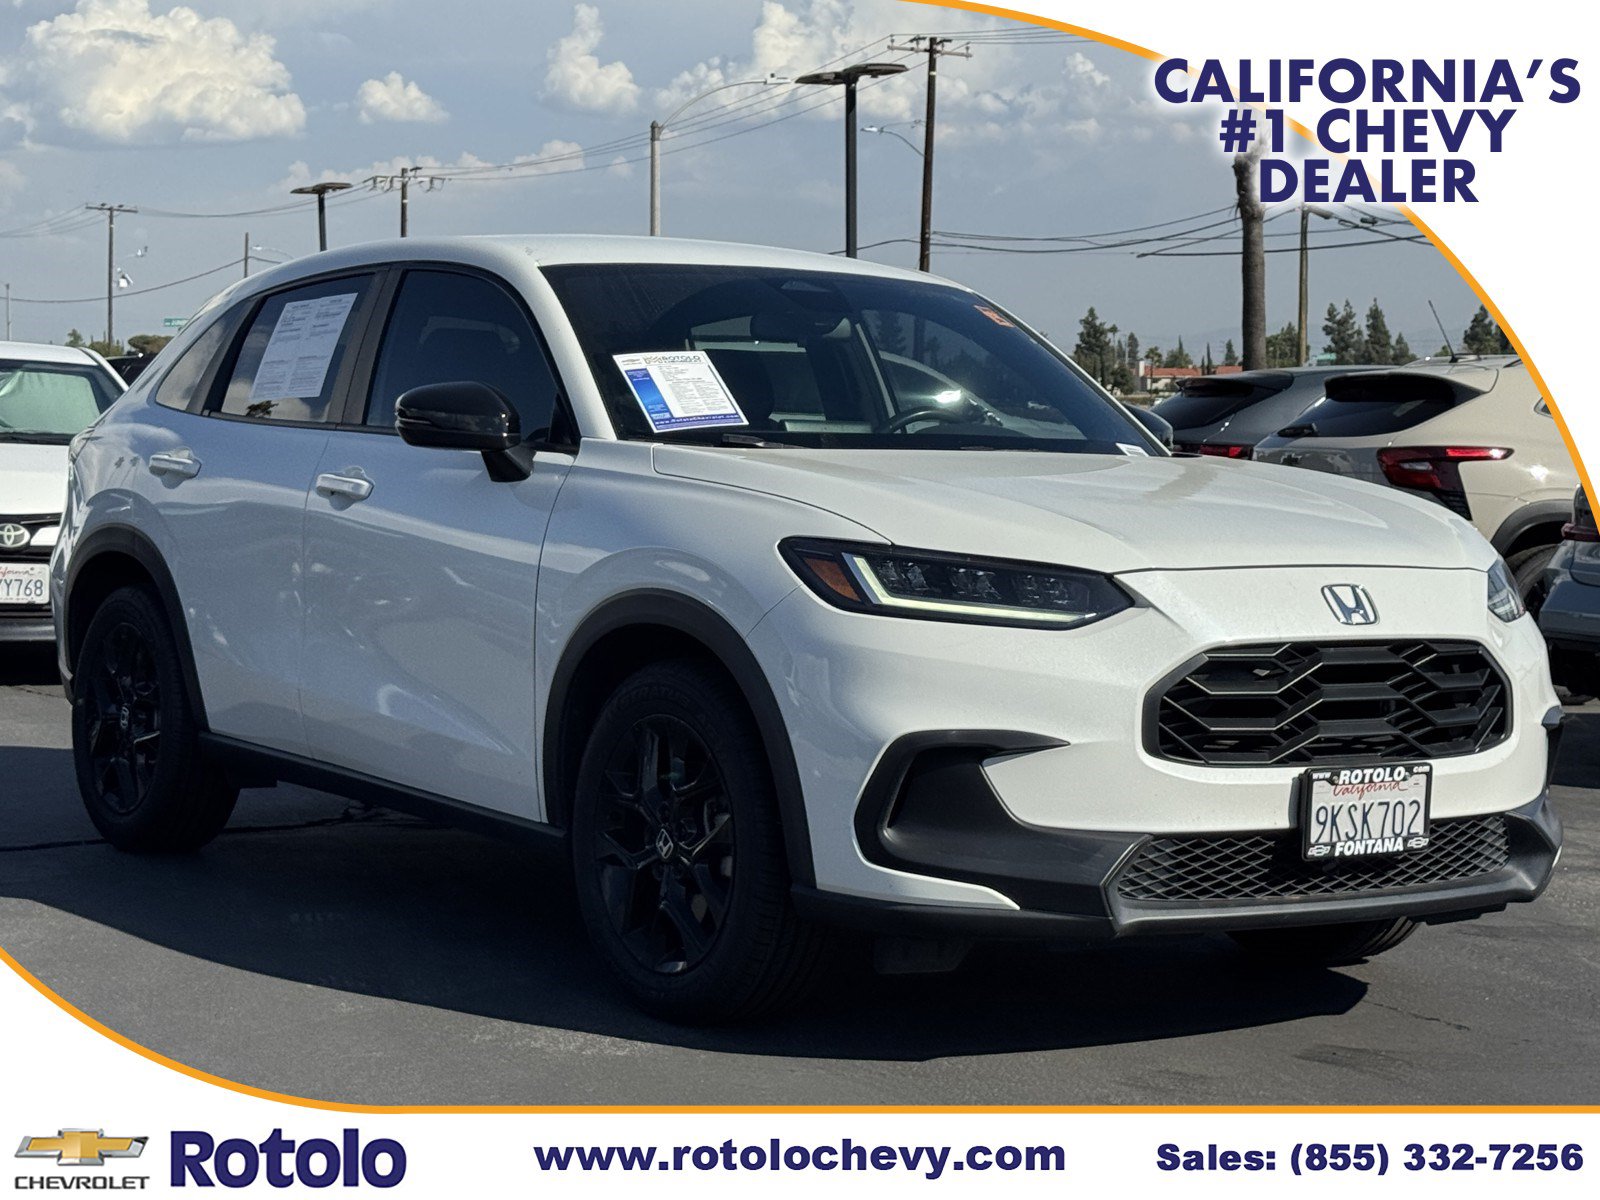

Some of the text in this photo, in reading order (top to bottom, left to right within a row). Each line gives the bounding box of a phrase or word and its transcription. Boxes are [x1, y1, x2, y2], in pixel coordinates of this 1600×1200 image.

[1312, 772, 1332, 780] www
[1338, 766, 1406, 785] ROTOLO
[1332, 781, 1409, 800] California
[1315, 800, 1421, 844] 9KSK702
[1334, 837, 1404, 857] FONTANA
